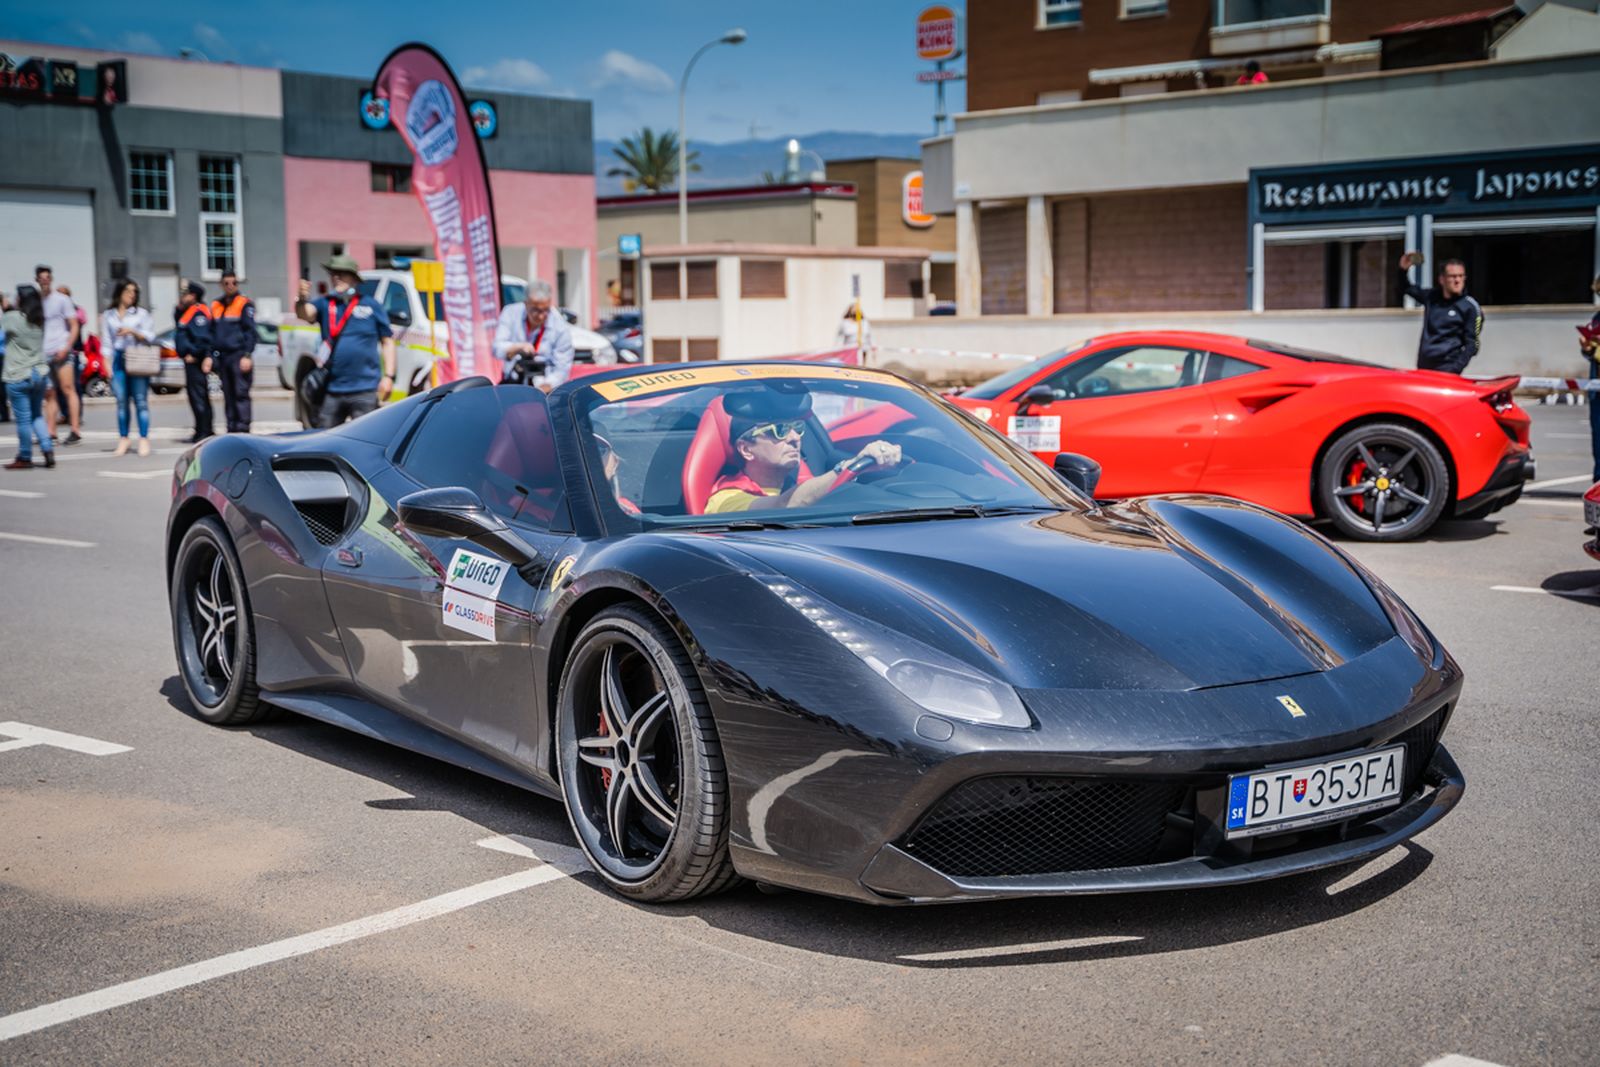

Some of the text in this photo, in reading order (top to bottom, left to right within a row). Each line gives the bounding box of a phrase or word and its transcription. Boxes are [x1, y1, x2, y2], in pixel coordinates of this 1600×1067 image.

[1264, 165, 1600, 207] Restaurante Japones
[640, 371, 697, 386] UNED
[465, 559, 502, 586] UNED
[455, 604, 494, 627] GLASSDRIVE
[1231, 807, 1244, 820] SK
